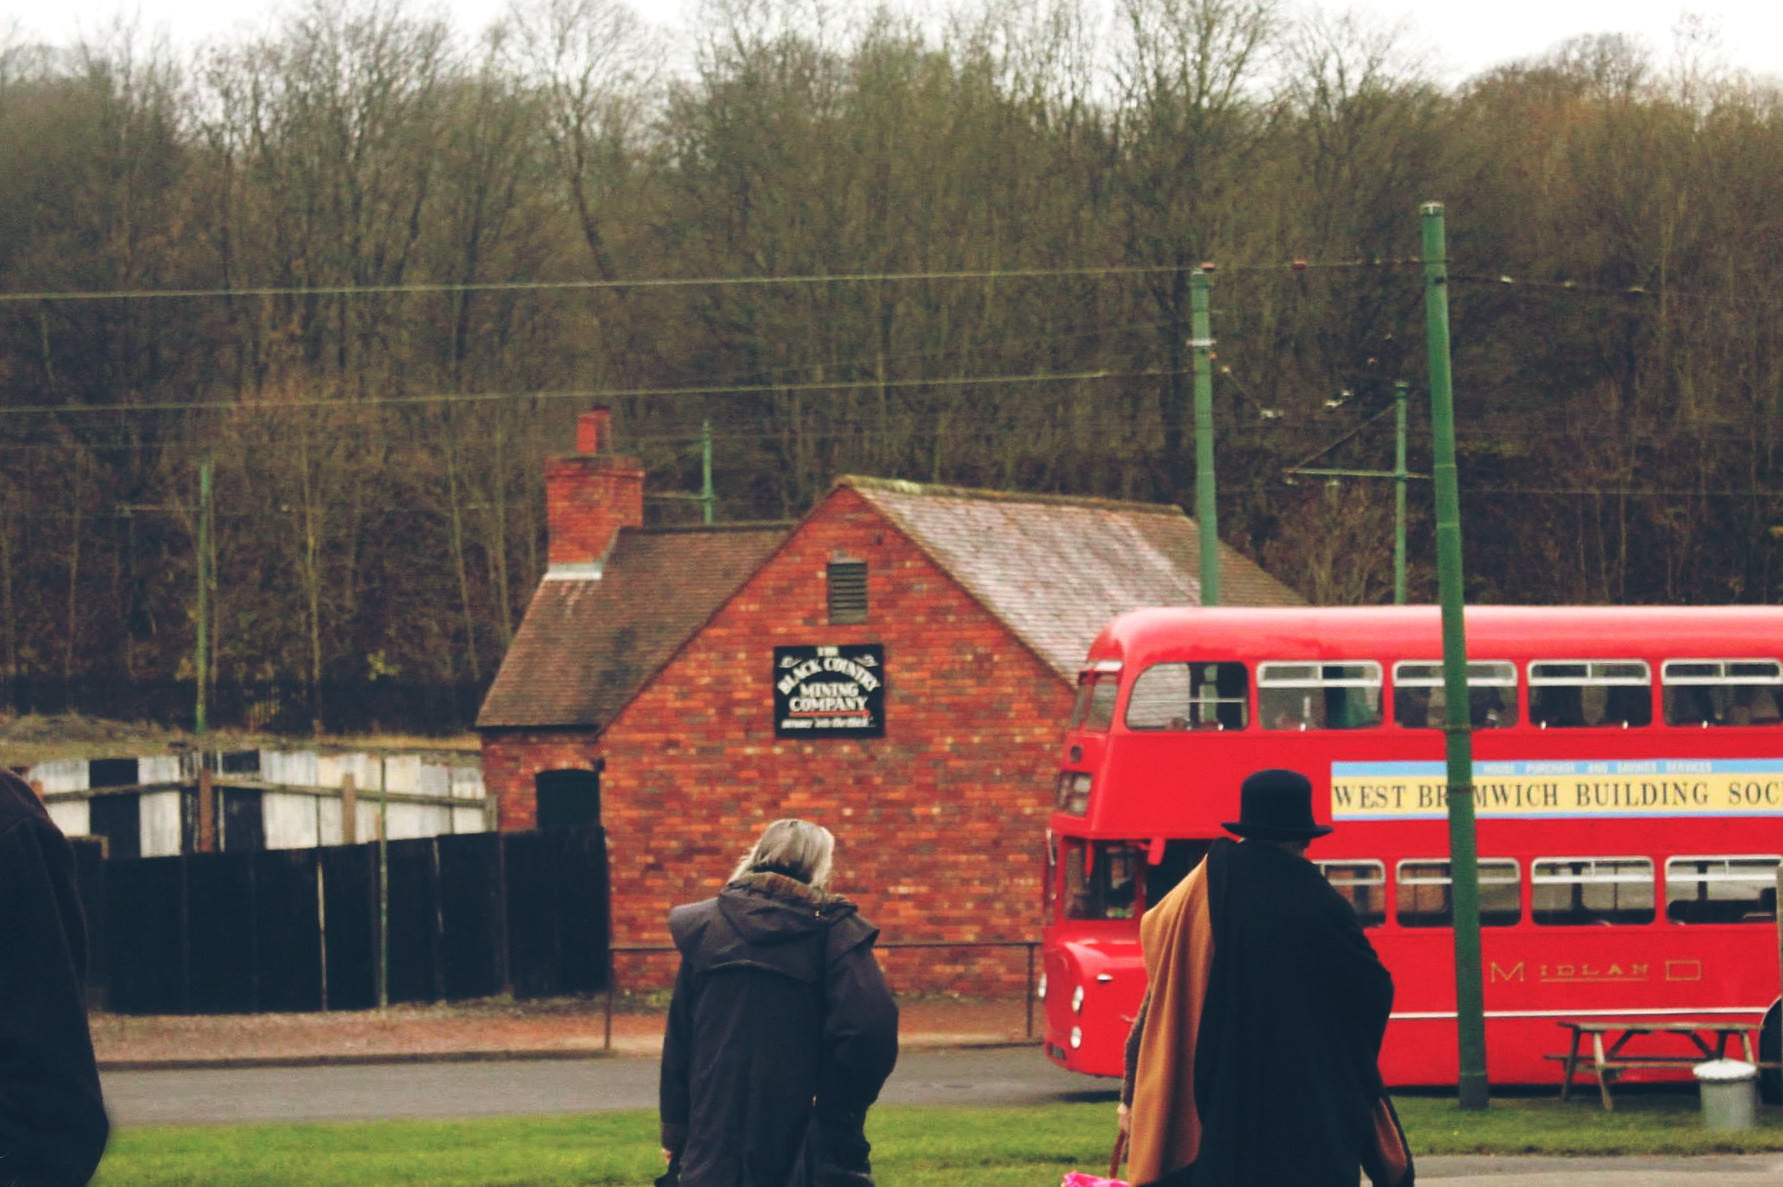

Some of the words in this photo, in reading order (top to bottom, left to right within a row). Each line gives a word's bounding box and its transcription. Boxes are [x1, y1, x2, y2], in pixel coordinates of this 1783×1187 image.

[777, 659, 822, 695] BLACK
[823, 658, 881, 691] COUNTRY
[800, 682, 859, 697] MINING
[789, 696, 868, 712] COMPANY
[1334, 785, 1406, 809] WEST
[1418, 783, 1558, 808] BRMWICH
[1576, 782, 1709, 807] BUILDING
[1728, 782, 1783, 806] SOC
